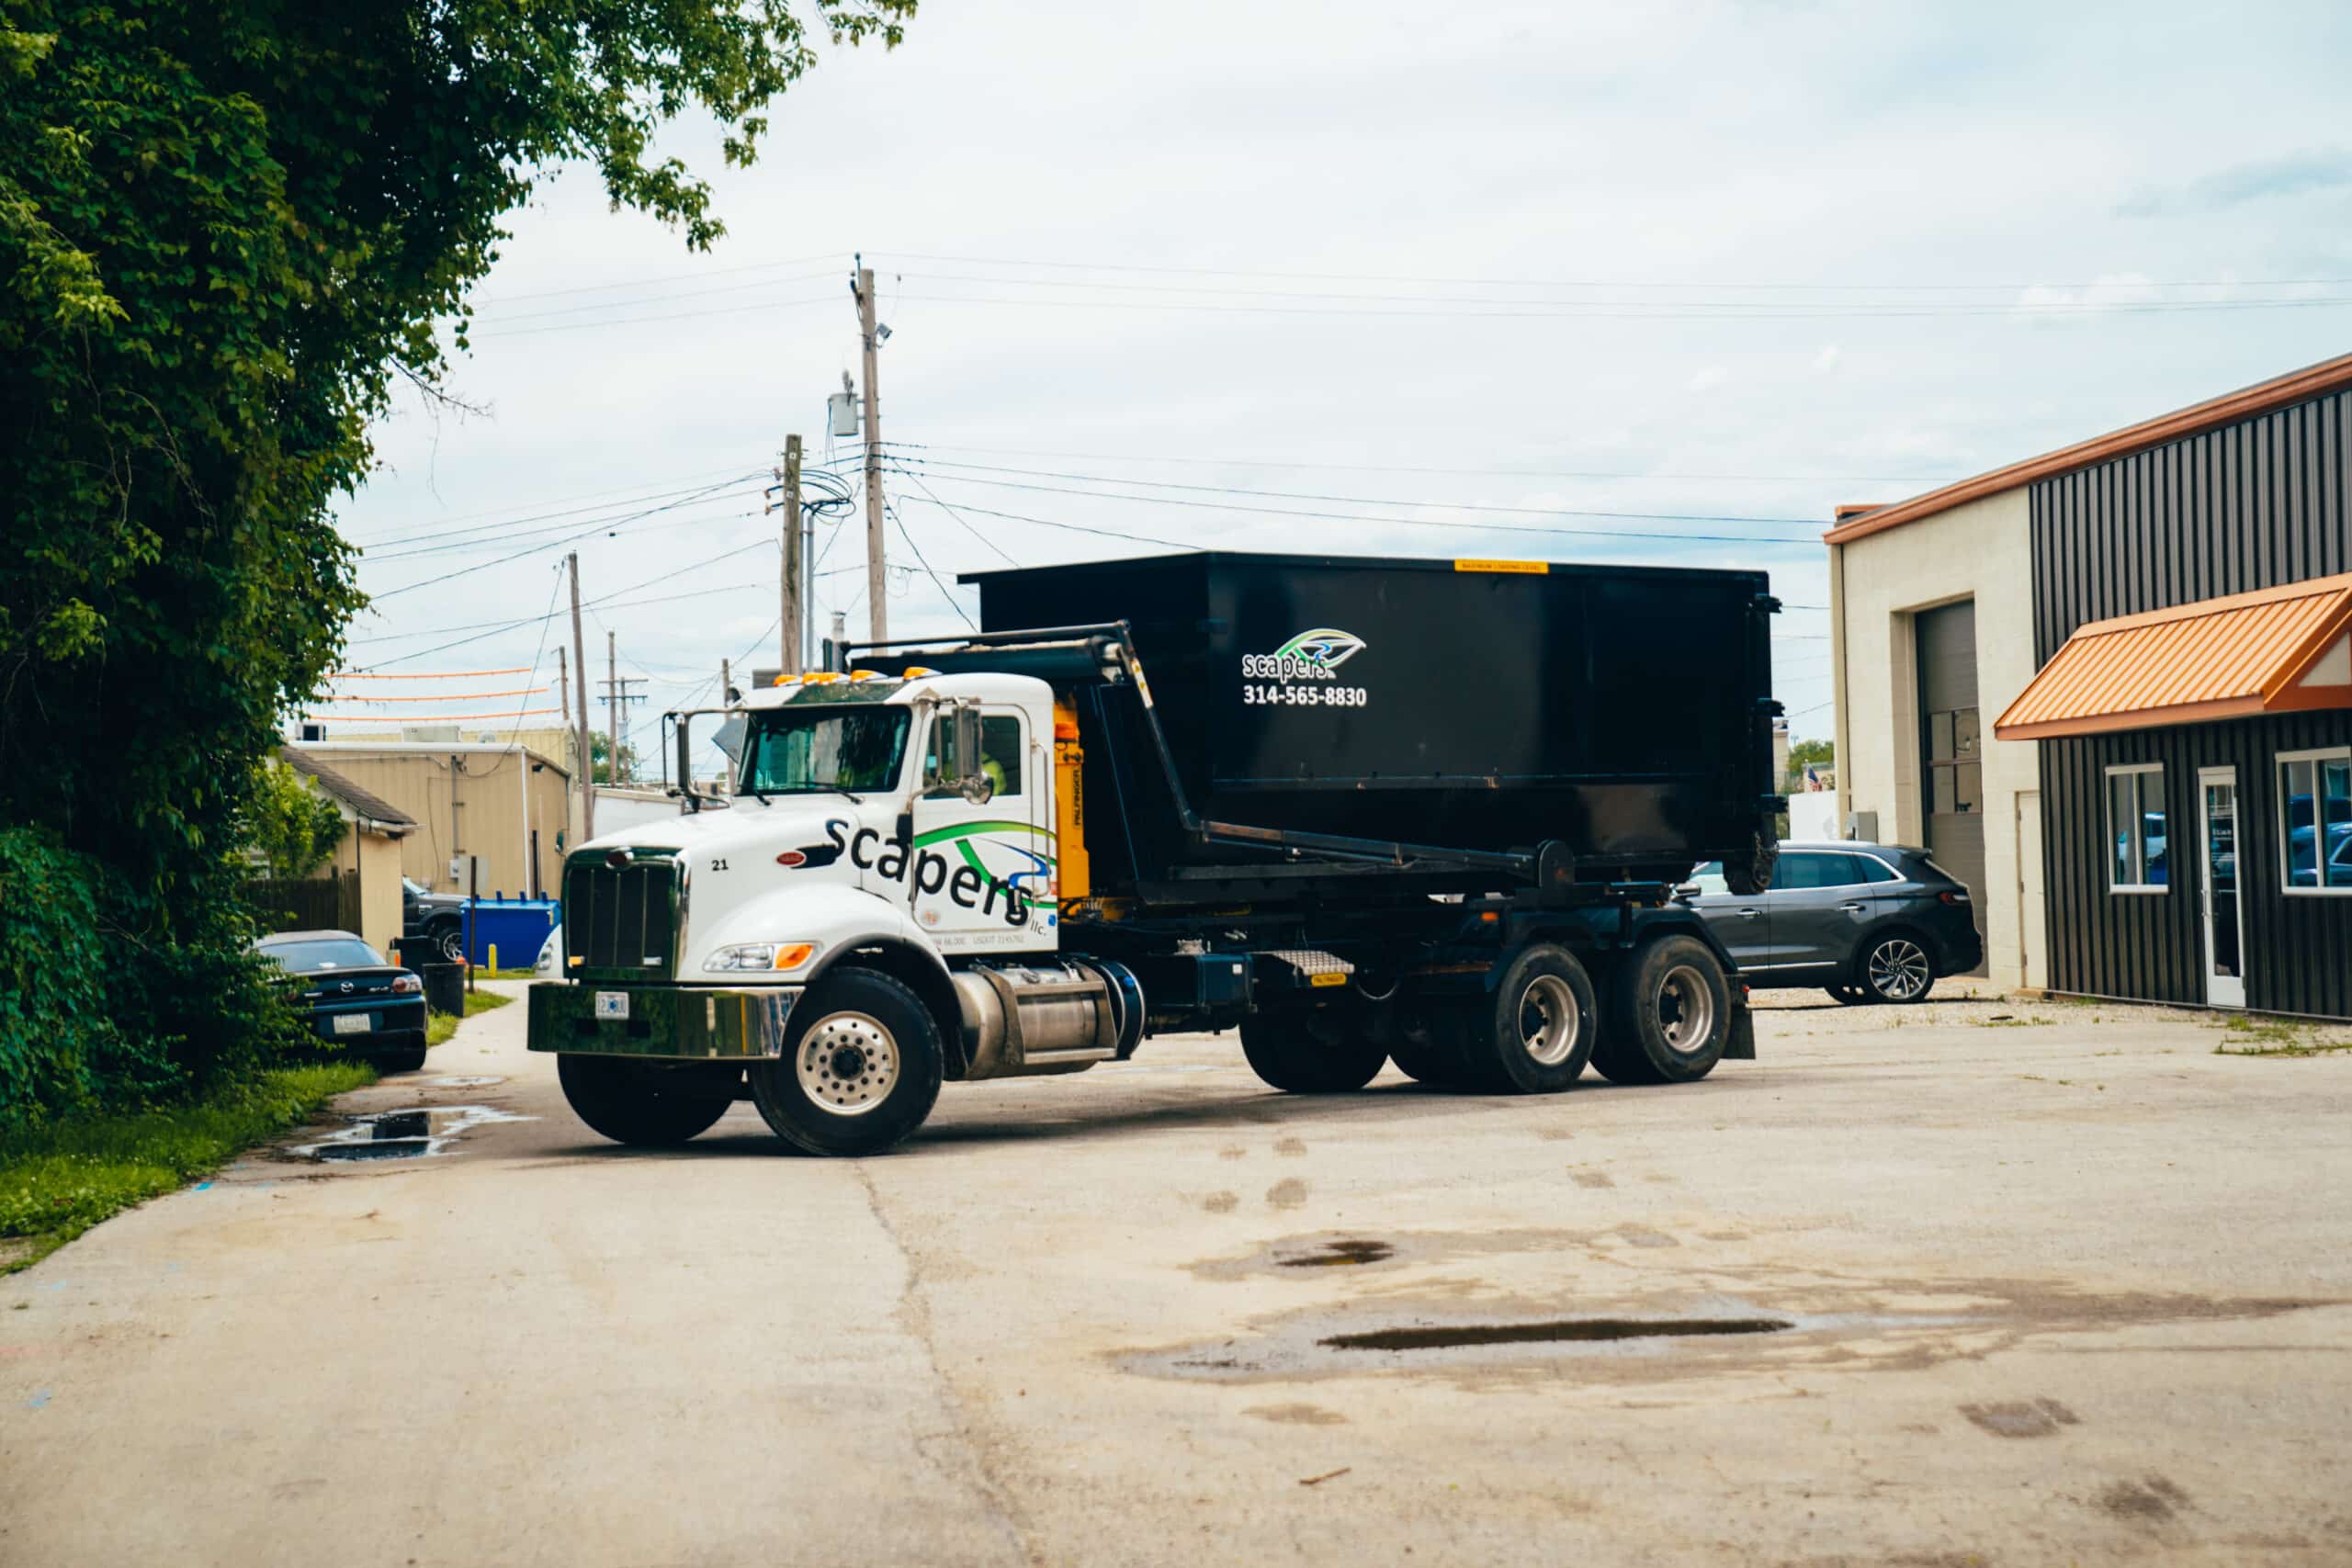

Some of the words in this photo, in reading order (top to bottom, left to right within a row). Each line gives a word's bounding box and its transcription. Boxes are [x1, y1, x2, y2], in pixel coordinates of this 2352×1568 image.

[1242, 653, 1329, 684] scapers
[1243, 684, 1367, 706] 314-565-8830
[711, 858, 729, 872] 21
